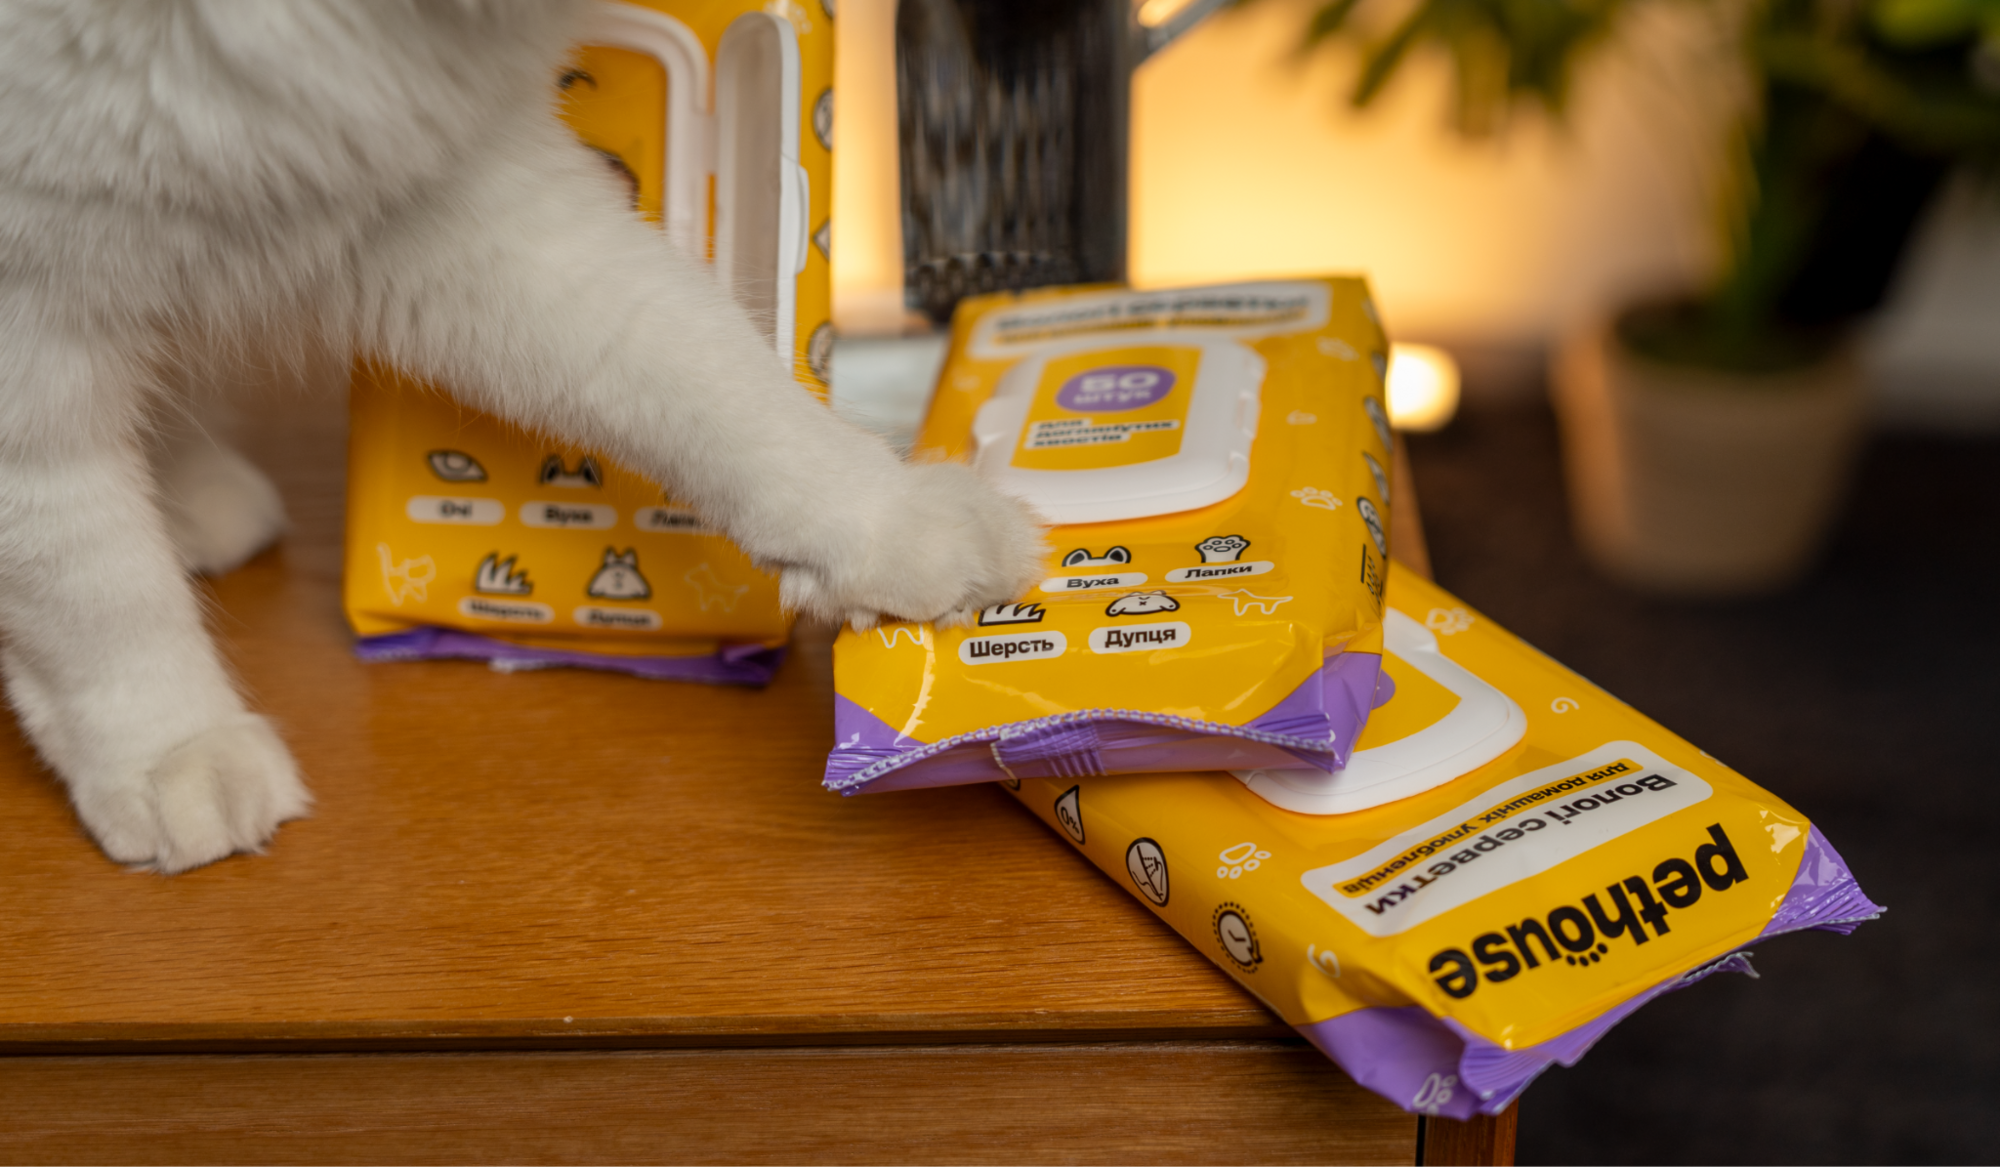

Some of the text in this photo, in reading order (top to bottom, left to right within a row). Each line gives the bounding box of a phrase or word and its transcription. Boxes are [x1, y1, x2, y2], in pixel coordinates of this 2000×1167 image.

[1081, 371, 1159, 393] 50
[1184, 565, 1252, 579] Лапки
[1067, 576, 1119, 589] Вуха
[970, 638, 1054, 658] Шерсть
[1105, 628, 1176, 648] Дупця
[1342, 762, 1630, 893] для домашніх улюбленців
[1364, 774, 1678, 915] Вологі серветки
